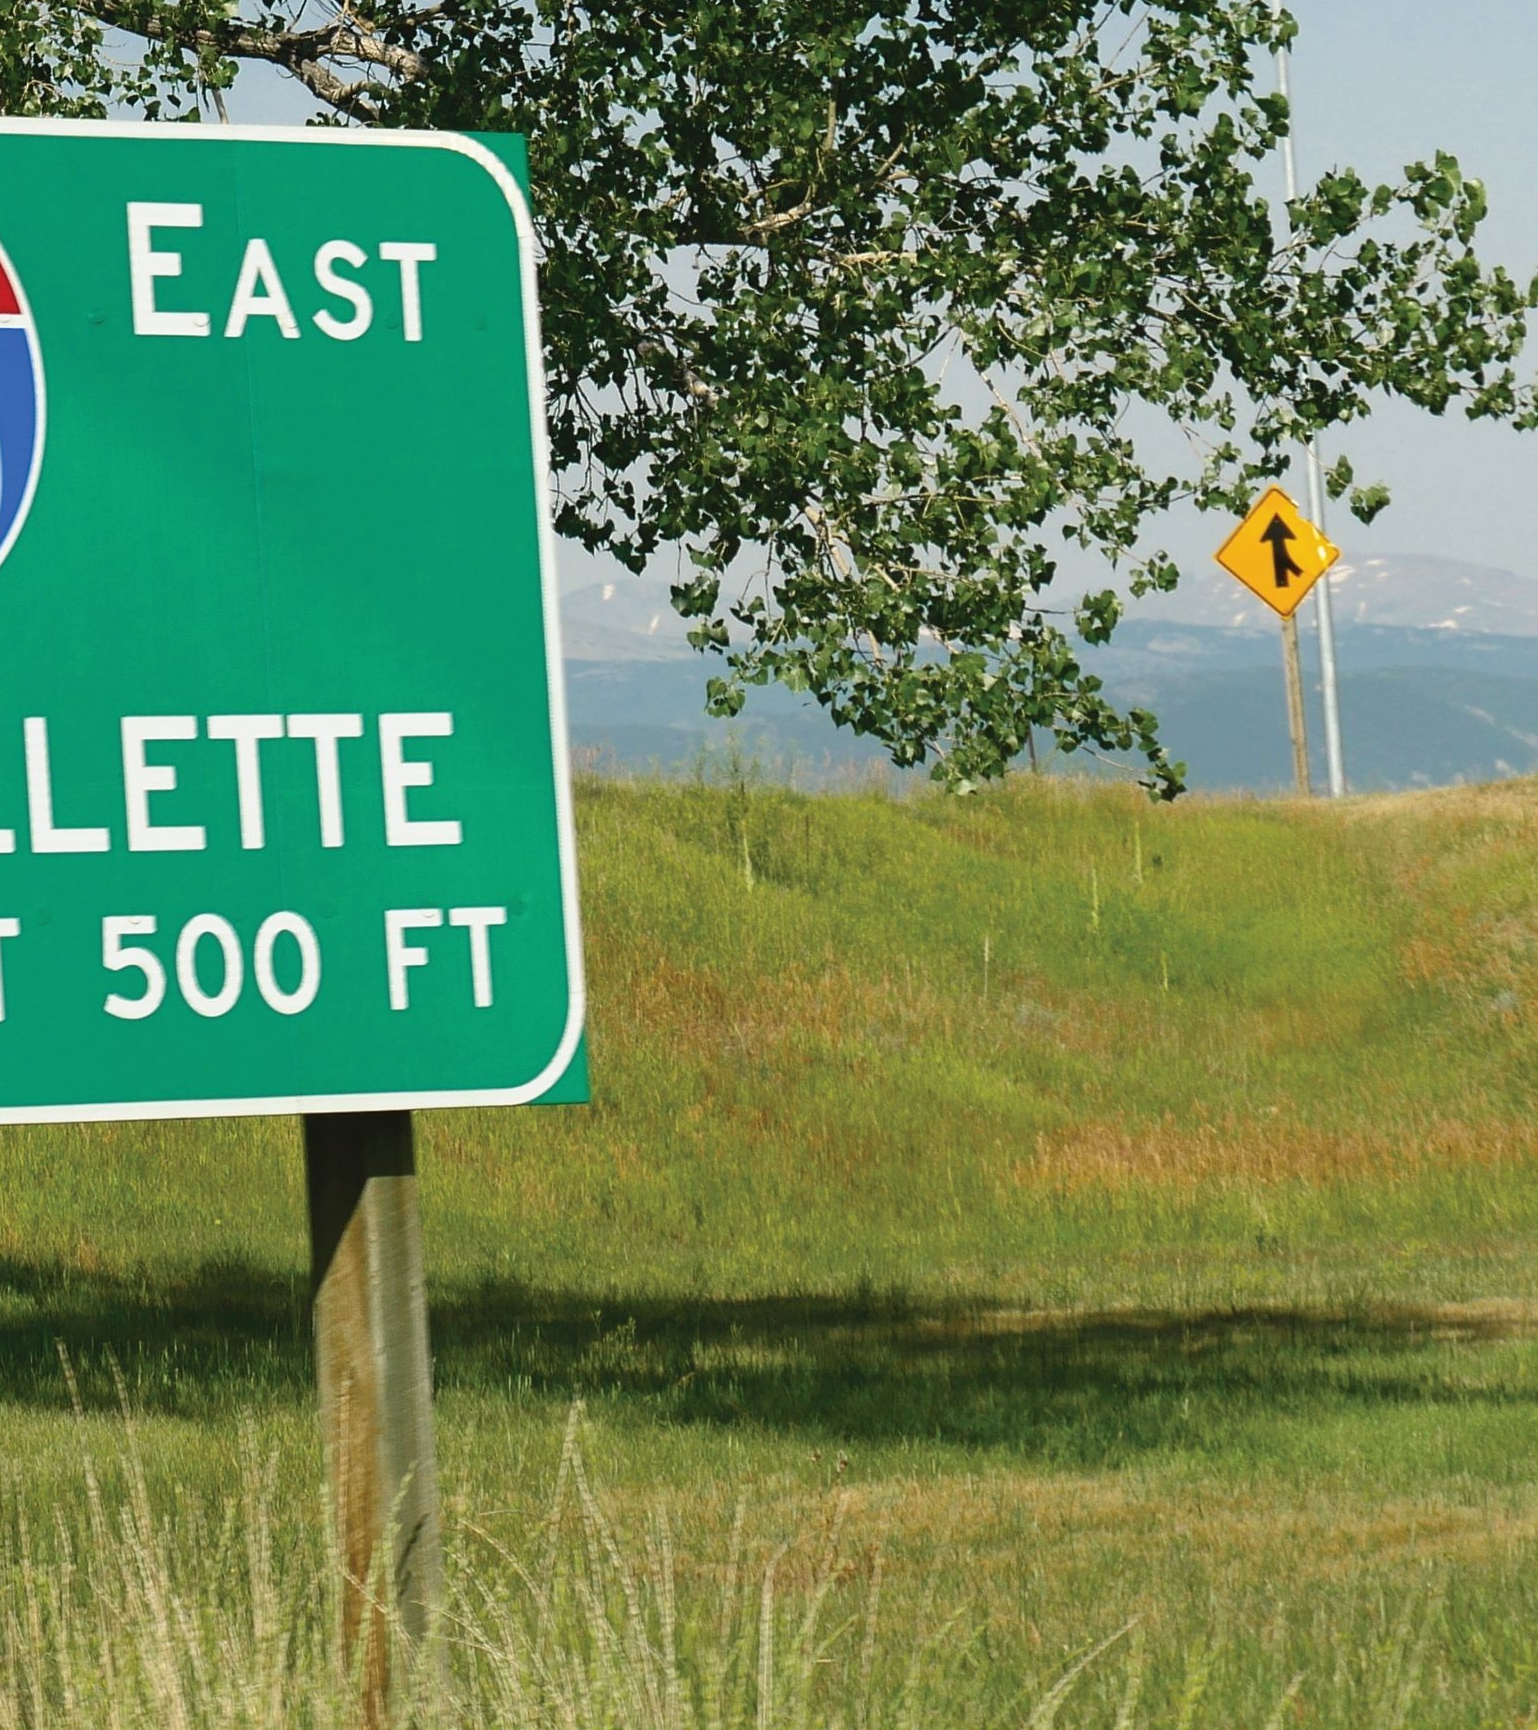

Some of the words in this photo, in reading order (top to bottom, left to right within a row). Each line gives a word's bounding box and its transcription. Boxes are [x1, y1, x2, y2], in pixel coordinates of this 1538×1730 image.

[126, 201, 437, 342] EAST
[102, 910, 321, 1020] 500
[384, 906, 507, 1011] FT
